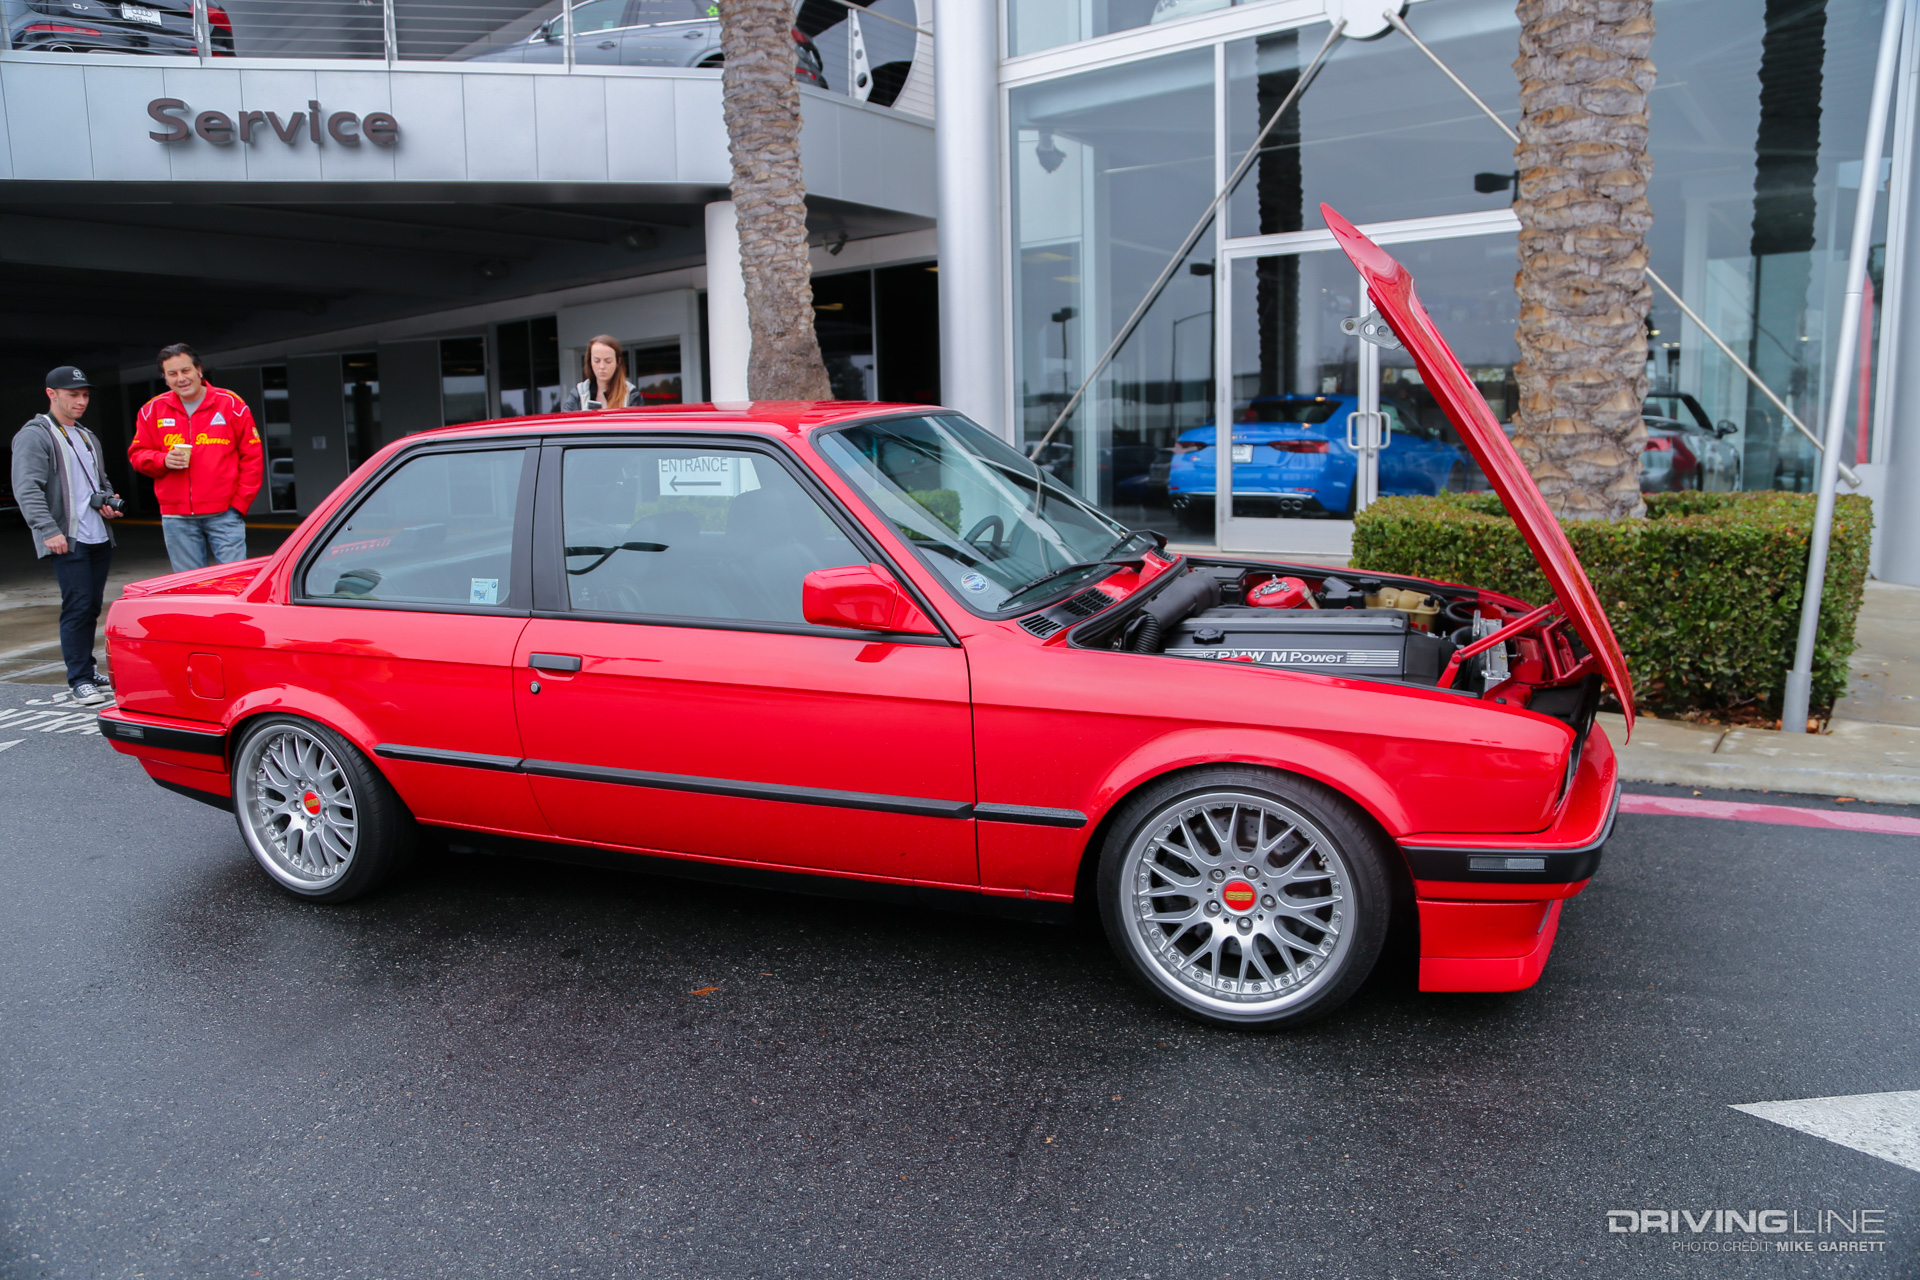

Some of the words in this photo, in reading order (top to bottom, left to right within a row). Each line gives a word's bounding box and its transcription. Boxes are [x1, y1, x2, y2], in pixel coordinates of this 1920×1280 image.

[147, 97, 399, 145] Service
[195, 432, 231, 445] Romeo
[660, 457, 728, 473] ENTRANCE
